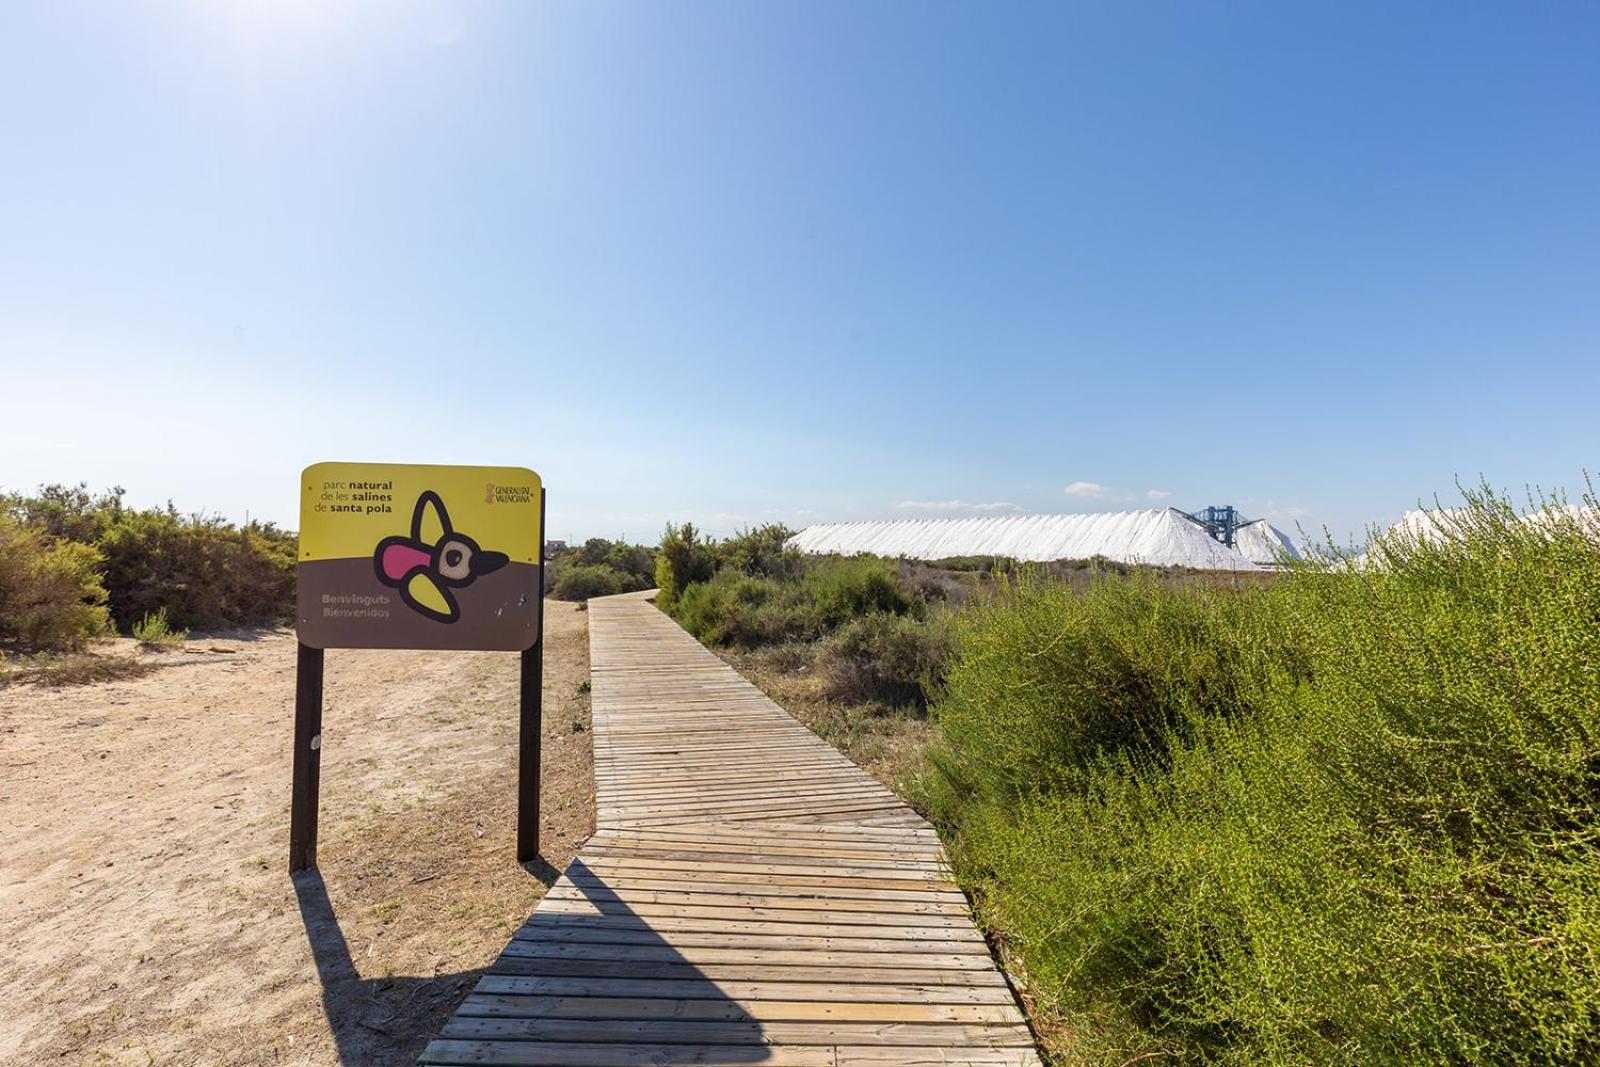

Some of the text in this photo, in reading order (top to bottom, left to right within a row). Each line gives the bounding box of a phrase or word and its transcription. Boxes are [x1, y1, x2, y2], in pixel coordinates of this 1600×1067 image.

[323, 481, 392, 490] parc natural
[320, 491, 392, 501] de les salines
[314, 503, 392, 515] de santa pola
[322, 593, 391, 606] Benvinguts
[322, 607, 390, 617] Bienvenidos
